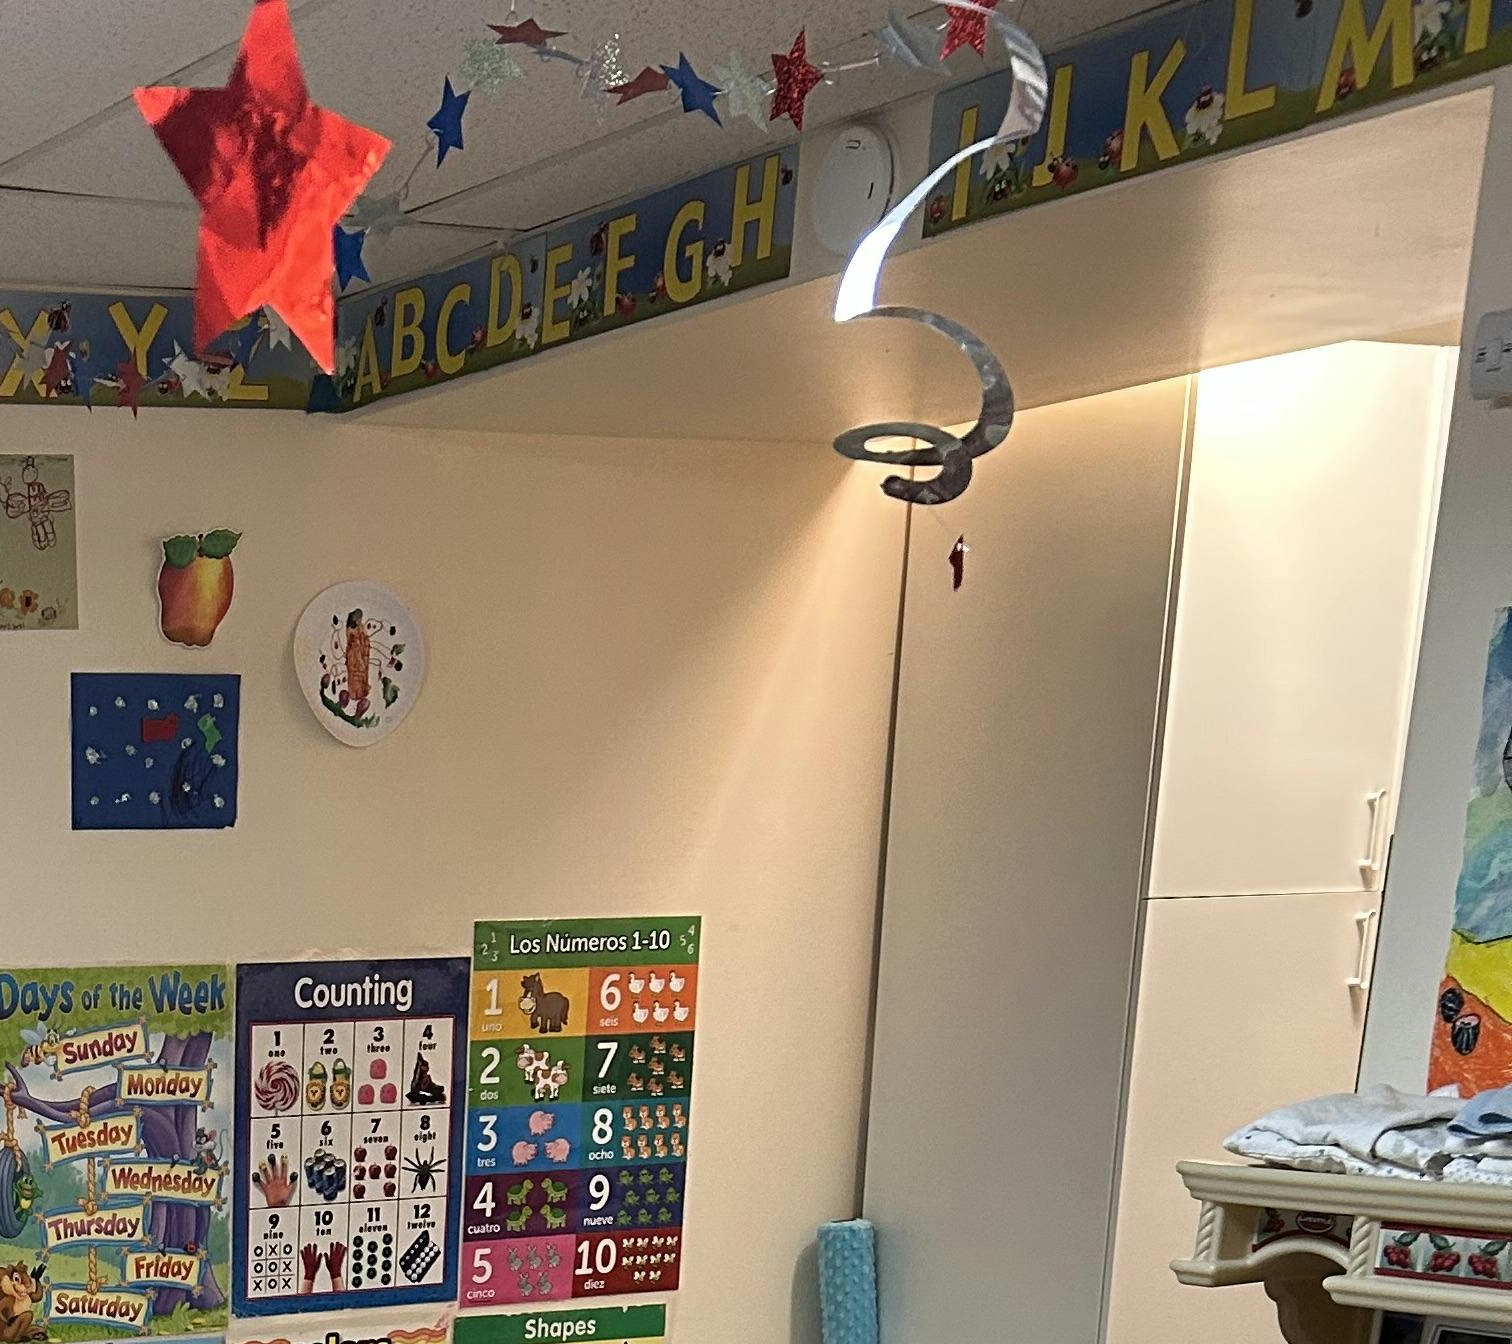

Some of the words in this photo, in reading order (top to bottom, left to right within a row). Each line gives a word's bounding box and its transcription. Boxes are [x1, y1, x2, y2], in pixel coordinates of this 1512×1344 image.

[510, 935, 541, 954] Los
[546, 932, 626, 953] Números
[632, 930, 670, 950] 1-10
[82, 991, 100, 1010] of
[110, 983, 143, 1011] the
[148, 971, 226, 1015] Week
[294, 974, 413, 1011] Counting
[600, 973, 621, 1011] 6
[422, 1025, 433, 1040] 4
[599, 1017, 619, 1027] seis
[62, 1031, 138, 1064] Sunday
[323, 1029, 335, 1045] 2
[597, 1041, 618, 1078] 7
[127, 1073, 203, 1098] Monday
[480, 1090, 498, 1100] dos
[593, 1084, 617, 1094] siete
[51, 1122, 134, 1155] Tuesday
[592, 1108, 614, 1145] 8
[477, 1157, 496, 1167] tres
[589, 1150, 614, 1160] ocho
[111, 1167, 217, 1196] Wednesday
[48, 1216, 141, 1240] Thursday
[468, 1224, 500, 1235] cuatro
[584, 1216, 613, 1226] nueve
[134, 1255, 194, 1280] Friday
[575, 1238, 617, 1275] 10
[467, 1289, 495, 1299] cinco
[584, 1279, 605, 1290] diez
[54, 1295, 143, 1321] Saturday
[525, 1318, 596, 1341] Shapes
